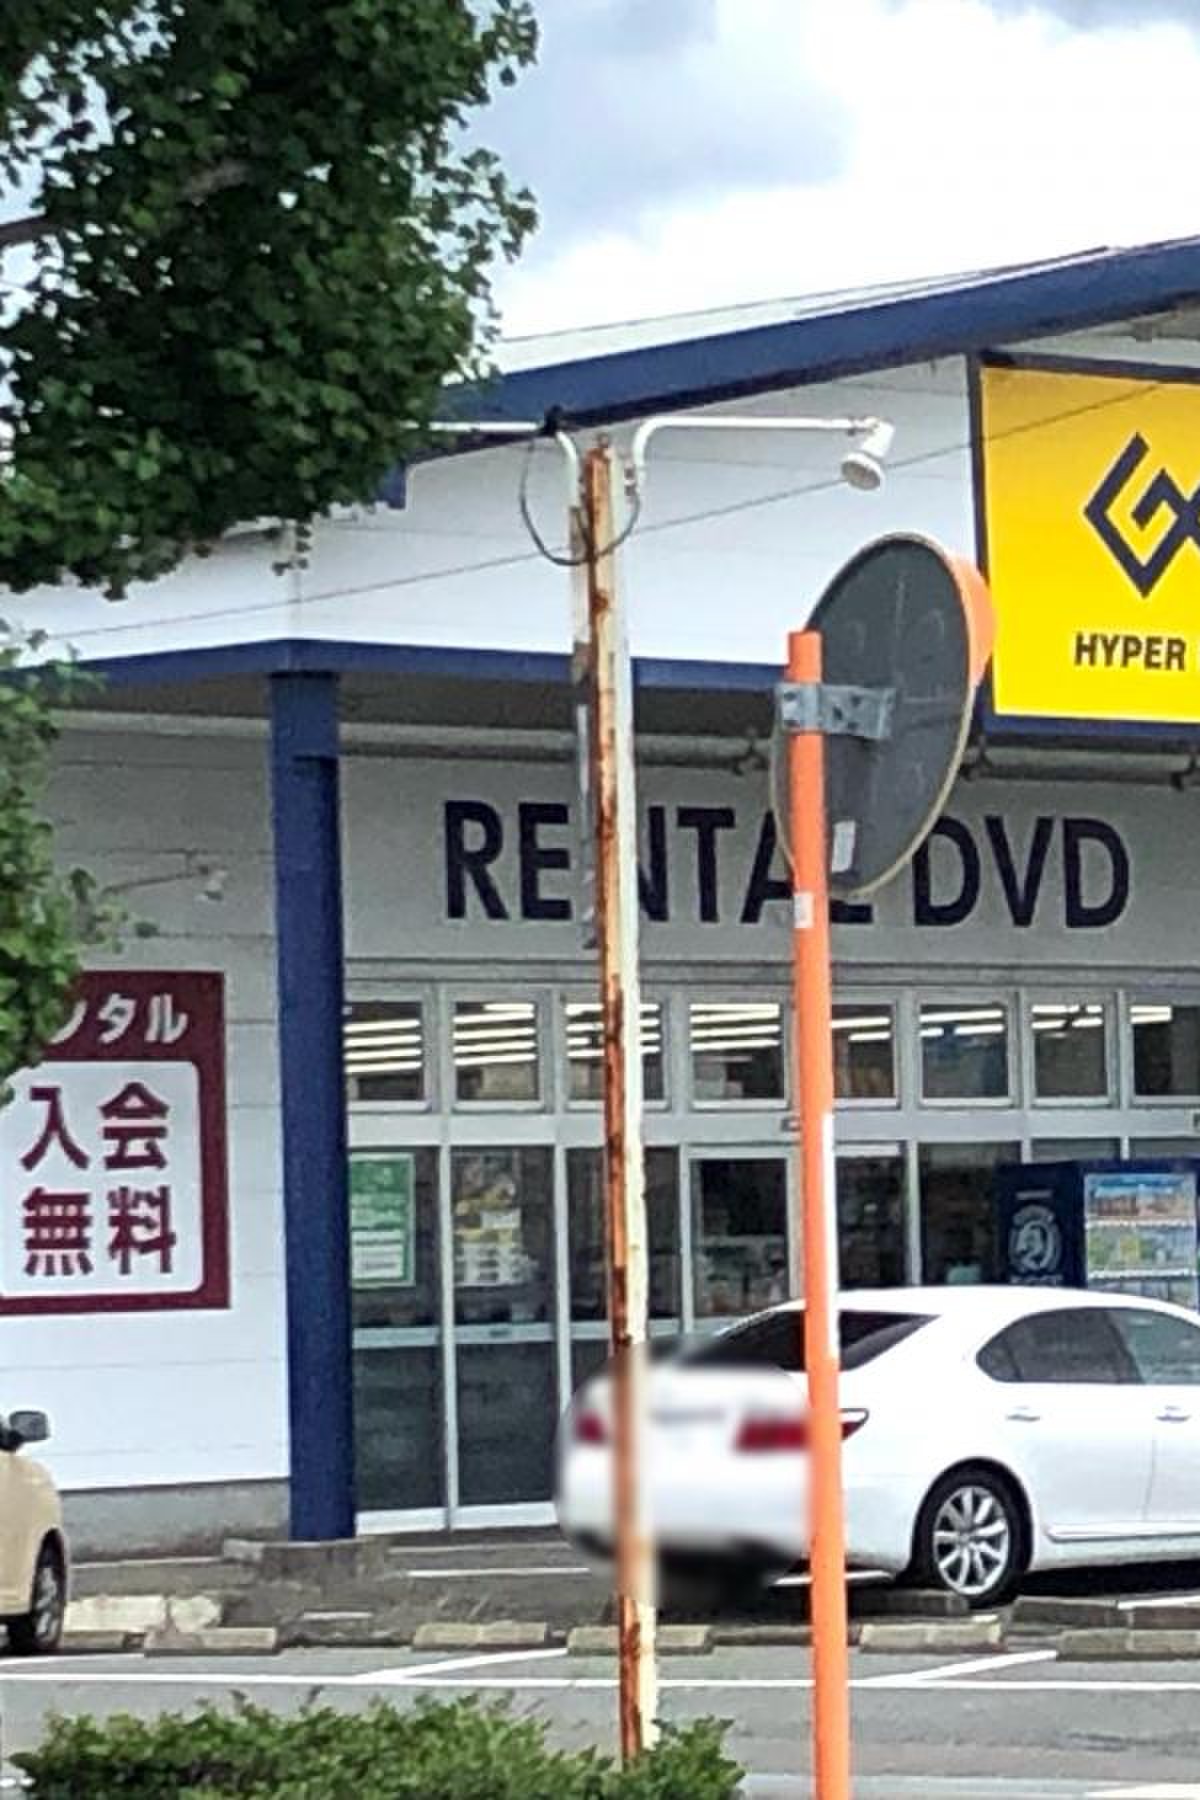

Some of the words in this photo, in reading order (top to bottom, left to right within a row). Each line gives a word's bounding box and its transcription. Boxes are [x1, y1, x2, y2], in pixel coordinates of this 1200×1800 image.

[1074, 633, 1186, 671] HYPER
[913, 815, 1130, 928] DVD
[20, 1081, 171, 1172] 入会
[22, 1185, 177, 1277] 無料
